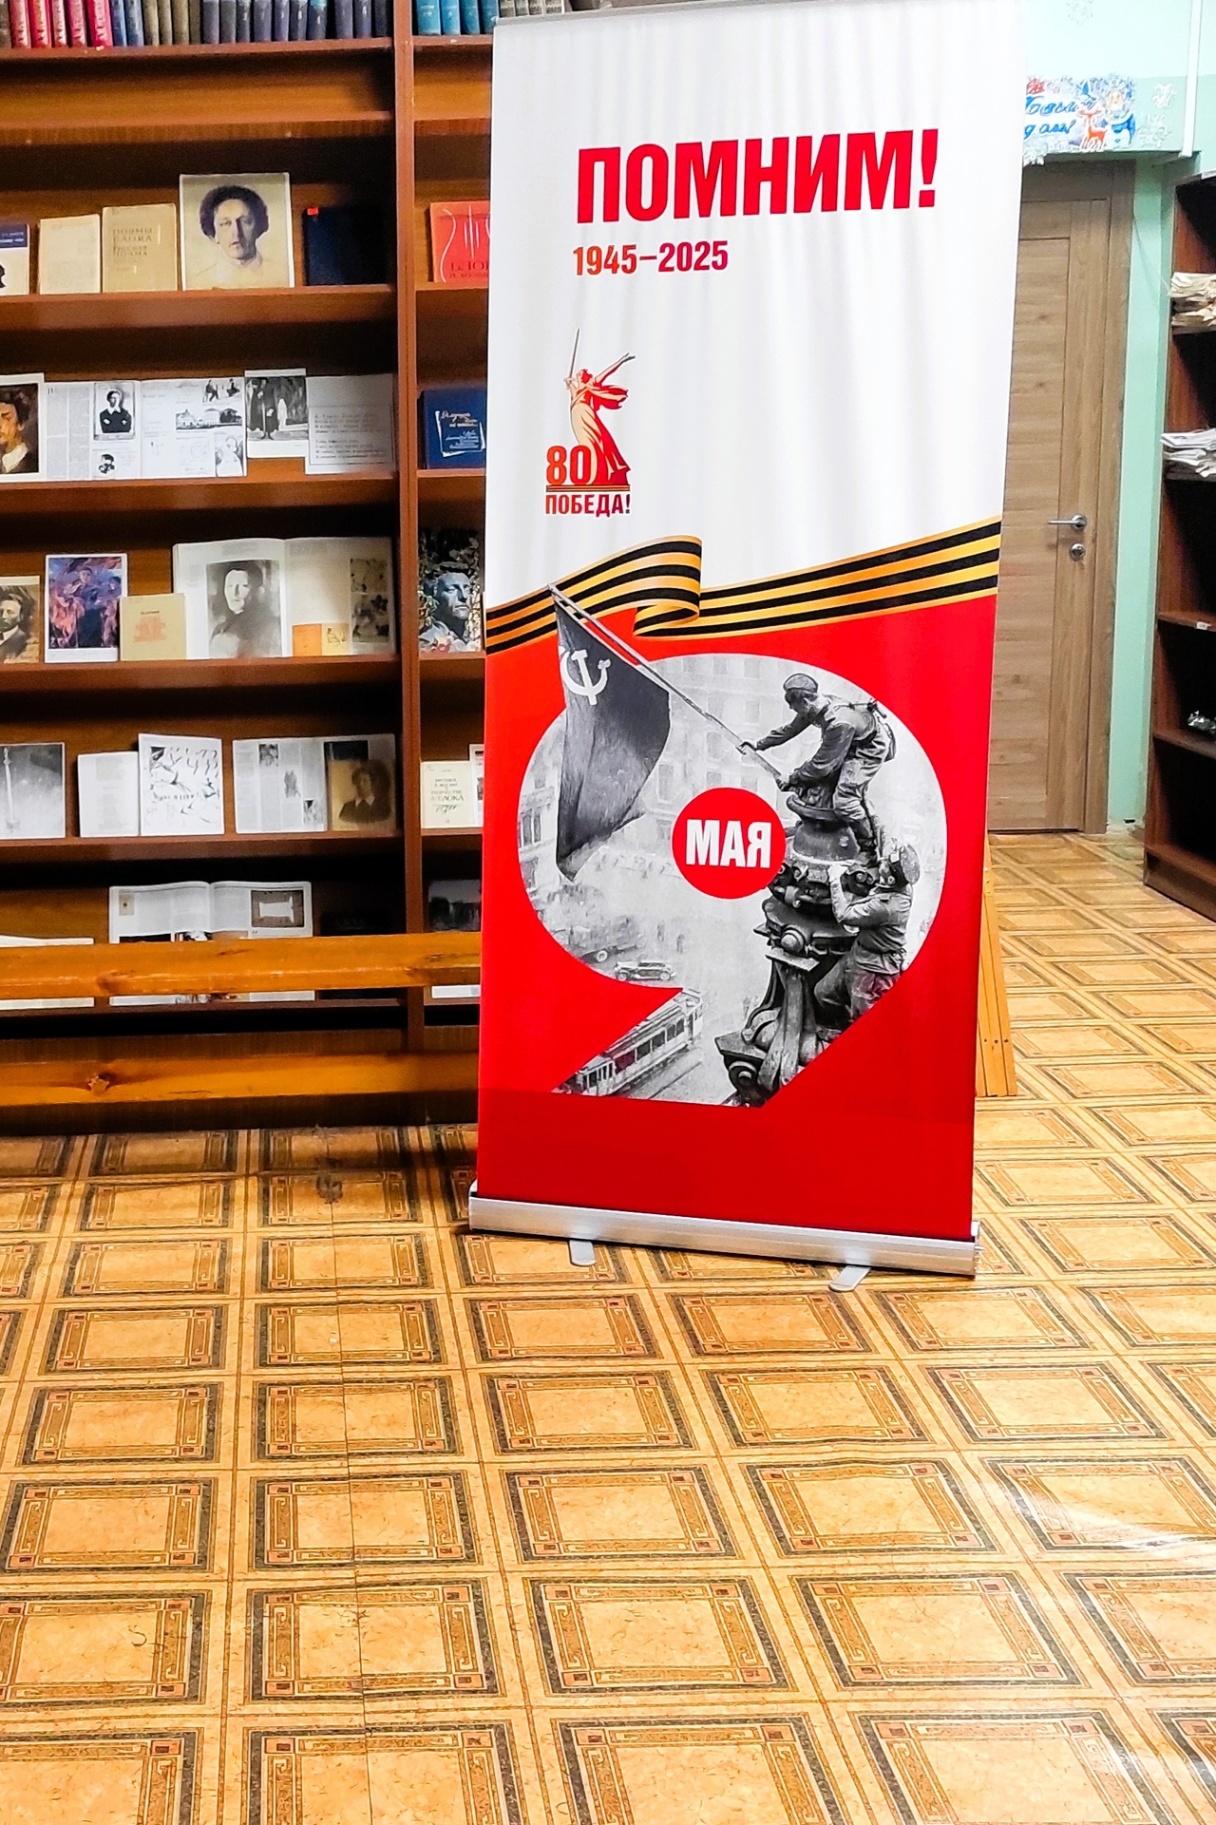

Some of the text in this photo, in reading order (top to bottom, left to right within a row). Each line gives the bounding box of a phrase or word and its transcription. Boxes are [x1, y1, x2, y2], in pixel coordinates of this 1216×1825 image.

[577, 128, 939, 223] ПОМНИМ!
[546, 445, 592, 486] 80
[545, 494, 631, 517] ПОБЕДА!
[686, 819, 772, 869] МАЯ
